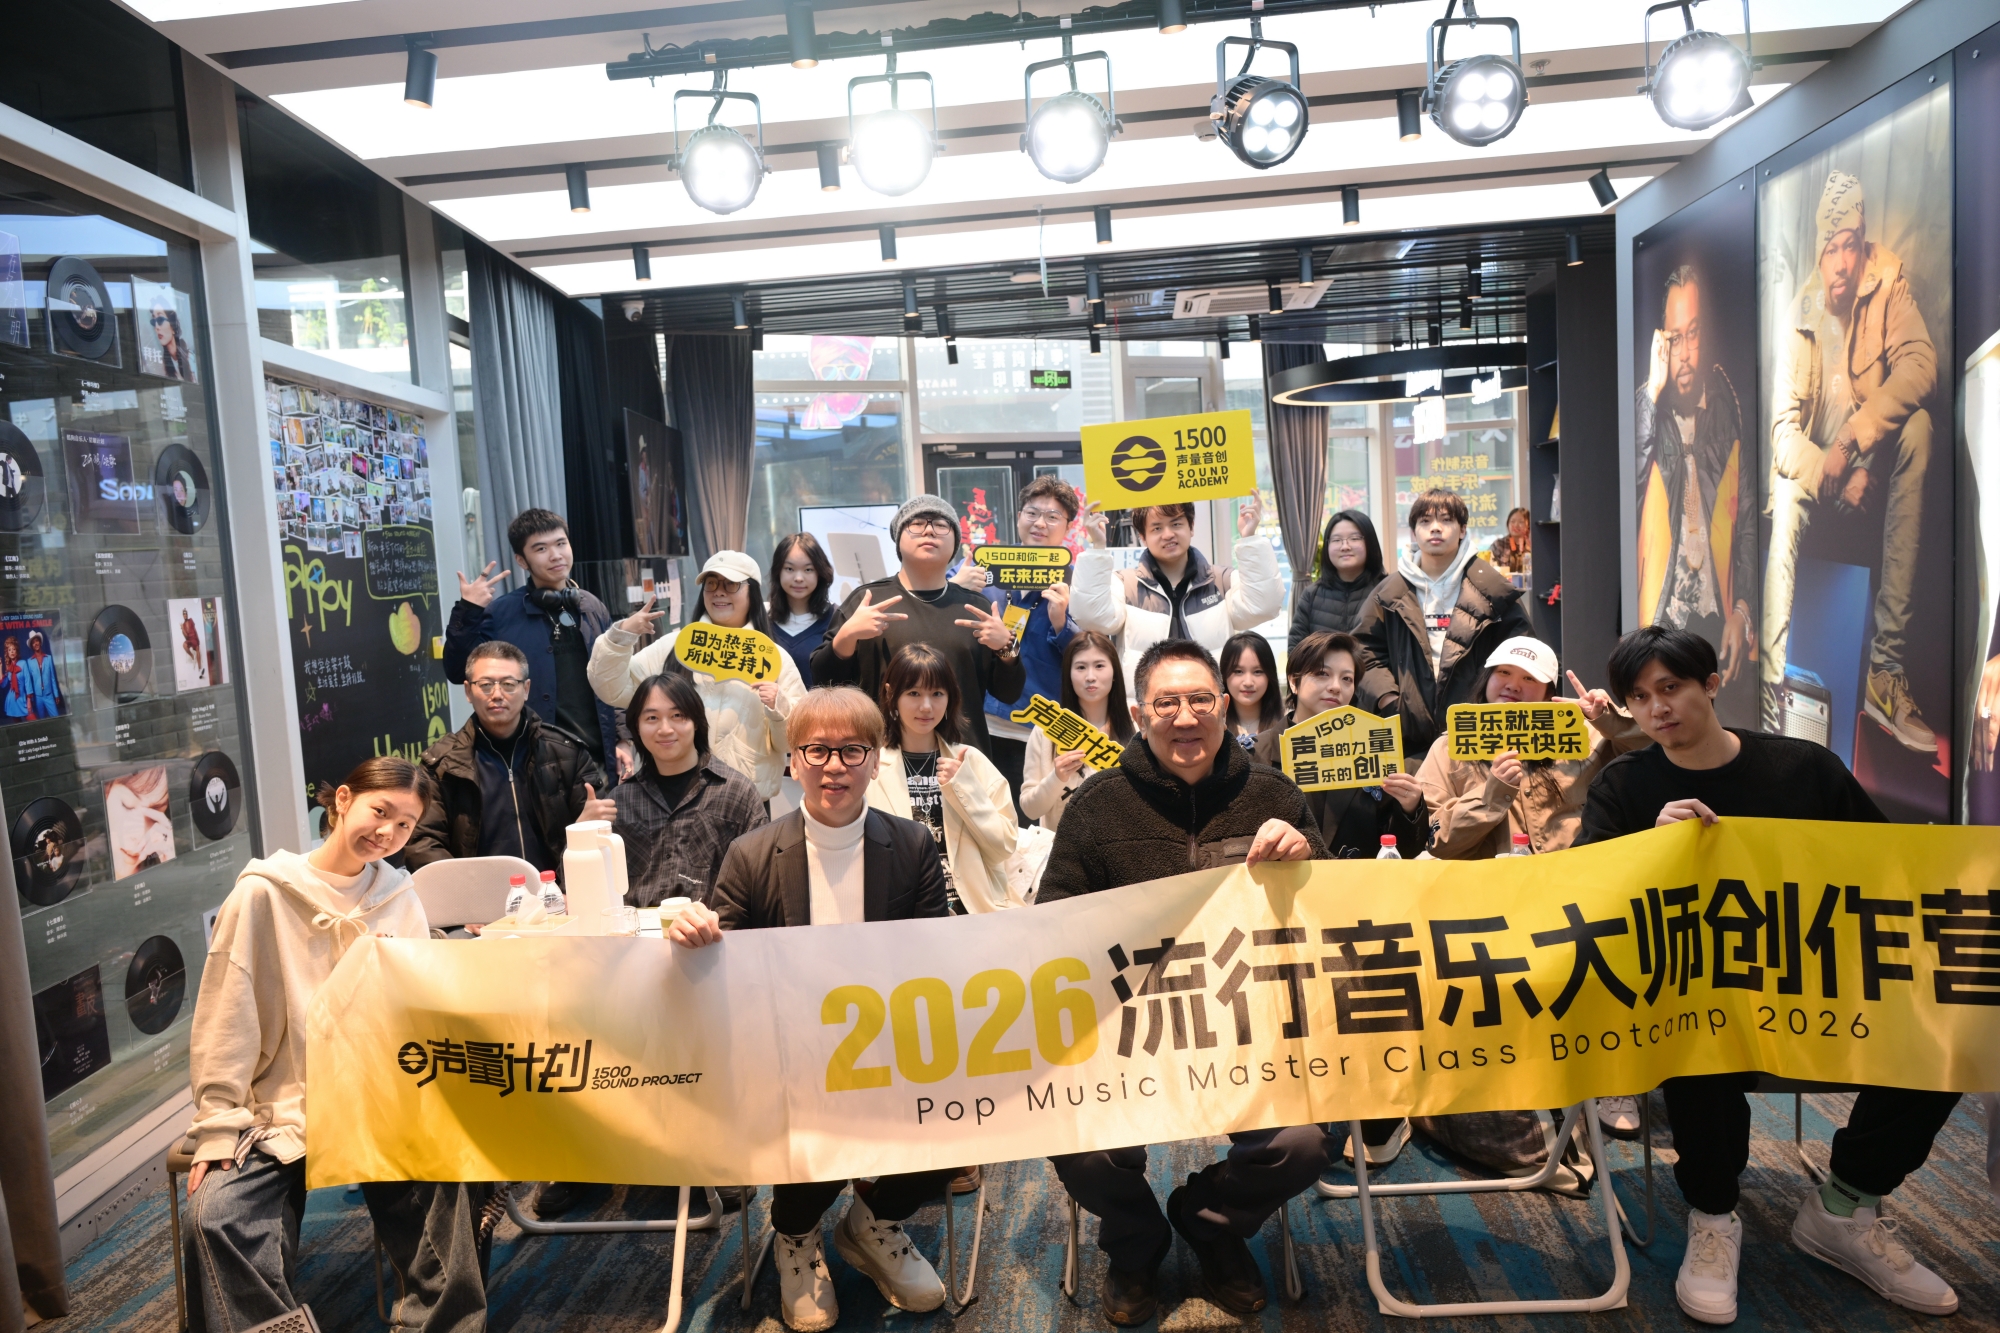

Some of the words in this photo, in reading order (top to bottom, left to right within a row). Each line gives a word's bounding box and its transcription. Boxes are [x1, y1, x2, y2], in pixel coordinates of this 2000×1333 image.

[1174, 425, 1226, 451] 1500
[1176, 450, 1228, 467] 声量音创
[1177, 465, 1229, 480] SOUND
[1178, 475, 1229, 489] ACADEMY
[985, 551, 1060, 562] 1500和你一起
[999, 568, 1065, 584] 乐来乐好
[5, 621, 25, 629] WITH
[25, 620, 31, 628] A
[32, 619, 53, 627] SMILE
[690, 629, 756, 655] 因为热爱
[684, 647, 757, 674] 所以坚持
[422, 682, 449, 719] 1500
[1454, 710, 1555, 732] 音乐就是
[1291, 728, 1395, 760] 声音的力量
[1455, 732, 1582, 755] 乐学乐快乐
[1294, 754, 1398, 785] 音乐的创造
[820, 957, 1099, 1092] 2026
[1107, 878, 2000, 1058] 流行音乐大师创作营
[416, 1037, 593, 1098] 声量计划
[592, 1066, 631, 1080] 1500
[916, 1096, 996, 1126] Pop
[1026, 1072, 1157, 1112] Music
[1187, 1054, 1351, 1091] Master
[1383, 1043, 1517, 1073] Class
[1549, 1007, 1728, 1062] Bootcamp
[1757, 1005, 1871, 1040] 2026
[591, 1077, 639, 1090] SOUND
[641, 1072, 703, 1087] PROJECT
